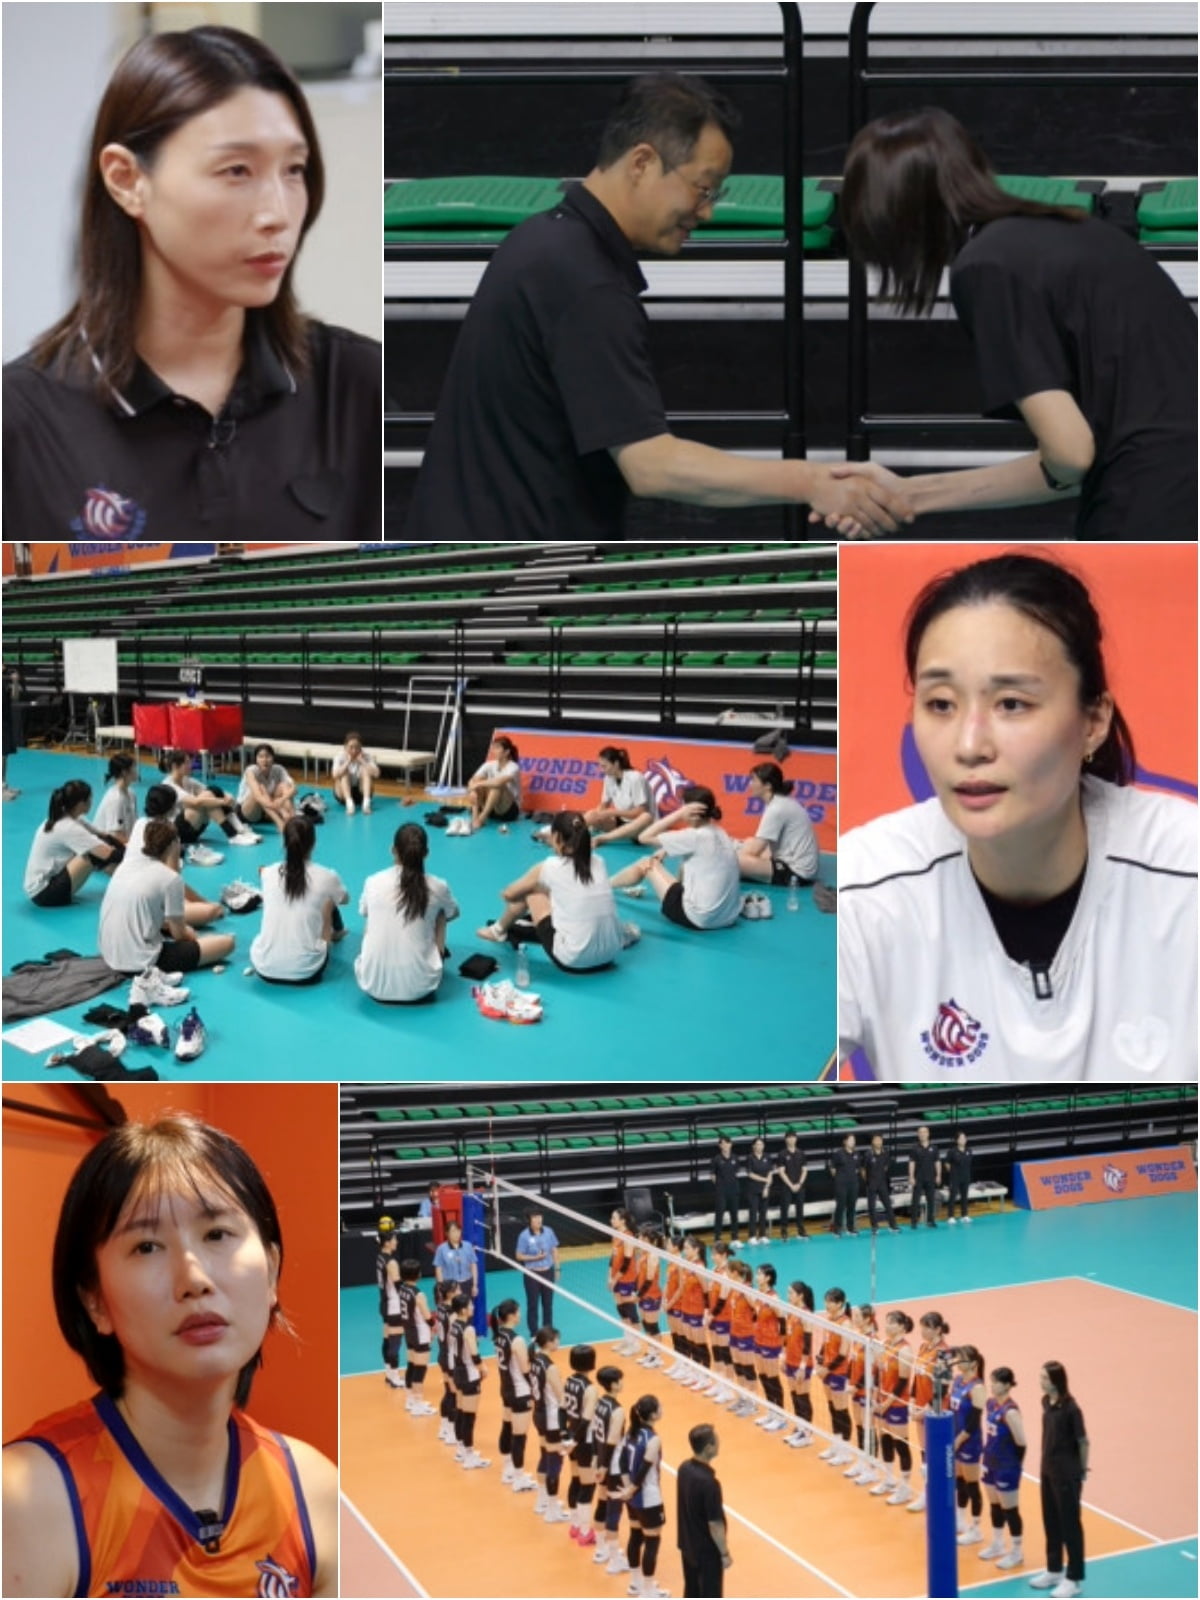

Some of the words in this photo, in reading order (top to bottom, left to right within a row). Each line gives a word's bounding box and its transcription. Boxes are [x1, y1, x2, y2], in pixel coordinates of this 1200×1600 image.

[519, 756, 605, 780] WONDE
[528, 774, 589, 797] DOGS
[722, 773, 838, 803] WDE
[744, 796, 825, 823] DS
[920, 1030, 965, 1068] WONDER
[1040, 1170, 1092, 1186] WONDER
[1137, 1160, 1186, 1175] WONDER
[1054, 1182, 1084, 1196] DOGS
[106, 1580, 181, 1595] WONDER
